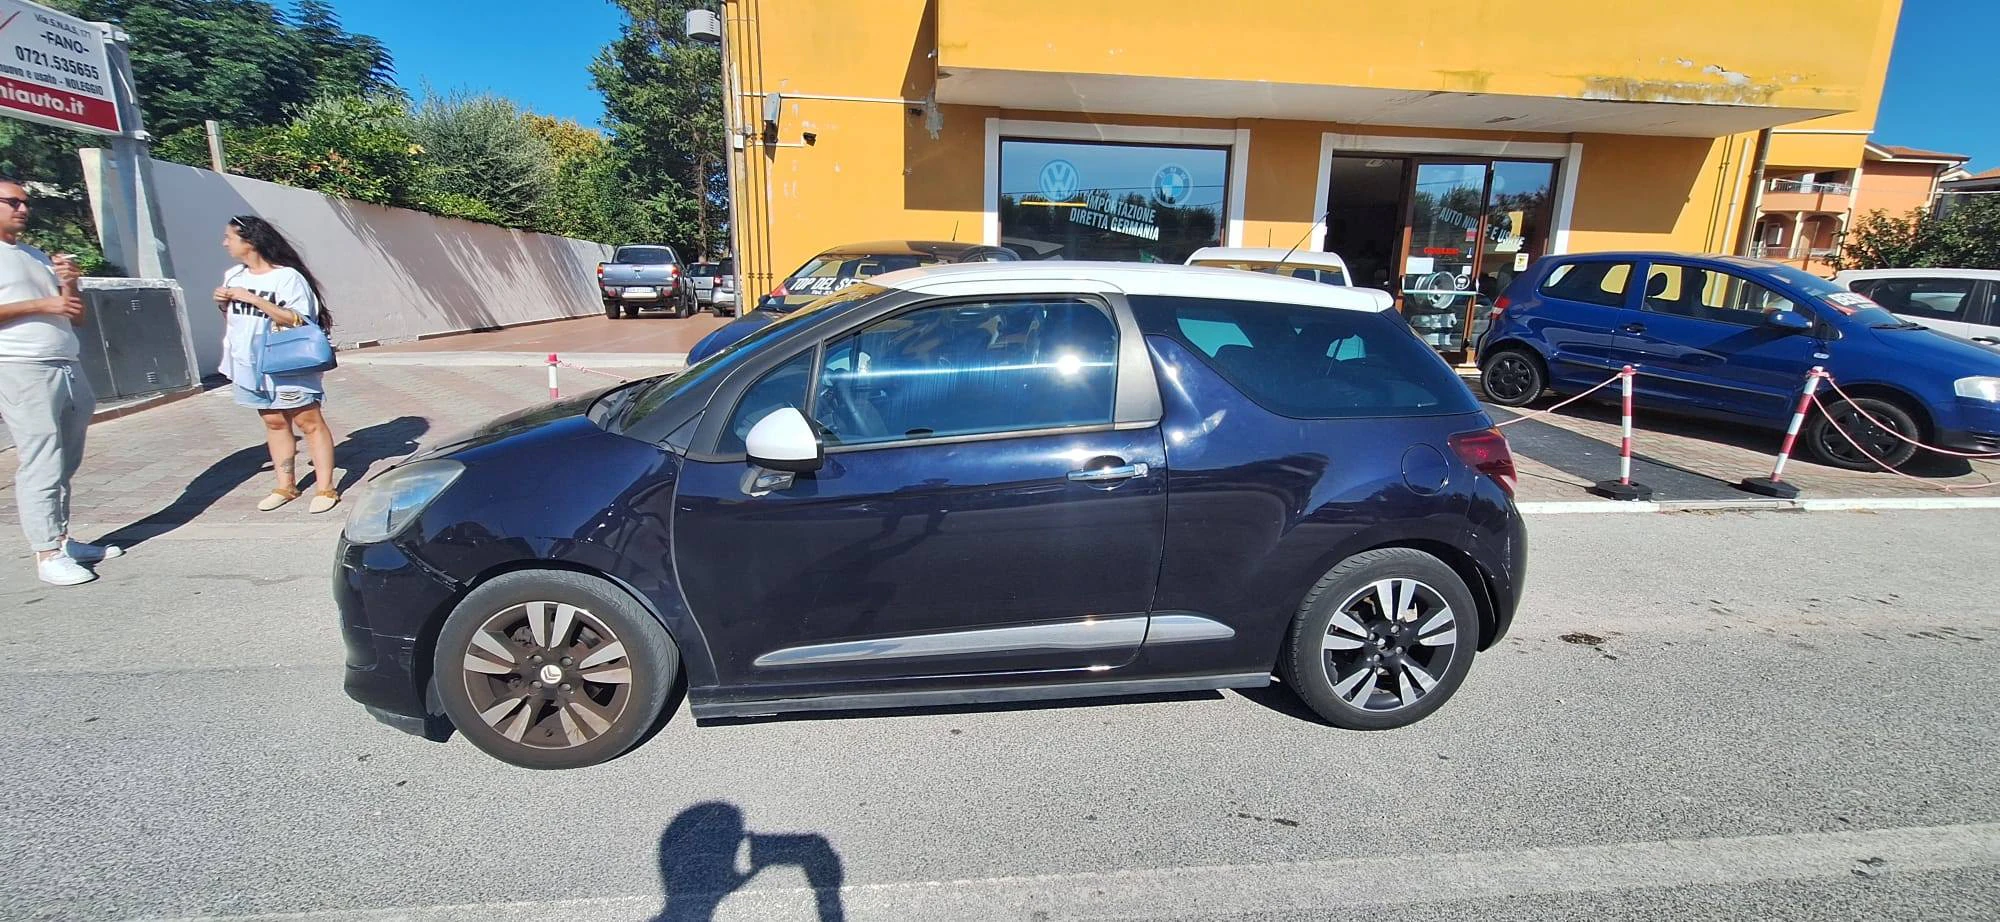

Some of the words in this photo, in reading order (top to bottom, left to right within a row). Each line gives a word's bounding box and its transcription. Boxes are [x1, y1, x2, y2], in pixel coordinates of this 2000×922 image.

[40, 31, 90, 53] -FANO-
[15, 45, 99, 80] 0721.535655
[26, 71, 32, 79] e
[34, 72, 57, 85] usato
[65, 77, 104, 96] NOLEGGIO
[1086, 194, 1157, 223] IMPORTAZIONE
[1069, 207, 1109, 230] DIRETTA
[1110, 216, 1160, 241] GERMANIA
[1439, 207, 1462, 227] AUTO
[1490, 226, 1499, 241] E
[789, 277, 817, 291] TOP
[810, 277, 837, 291] DEL
